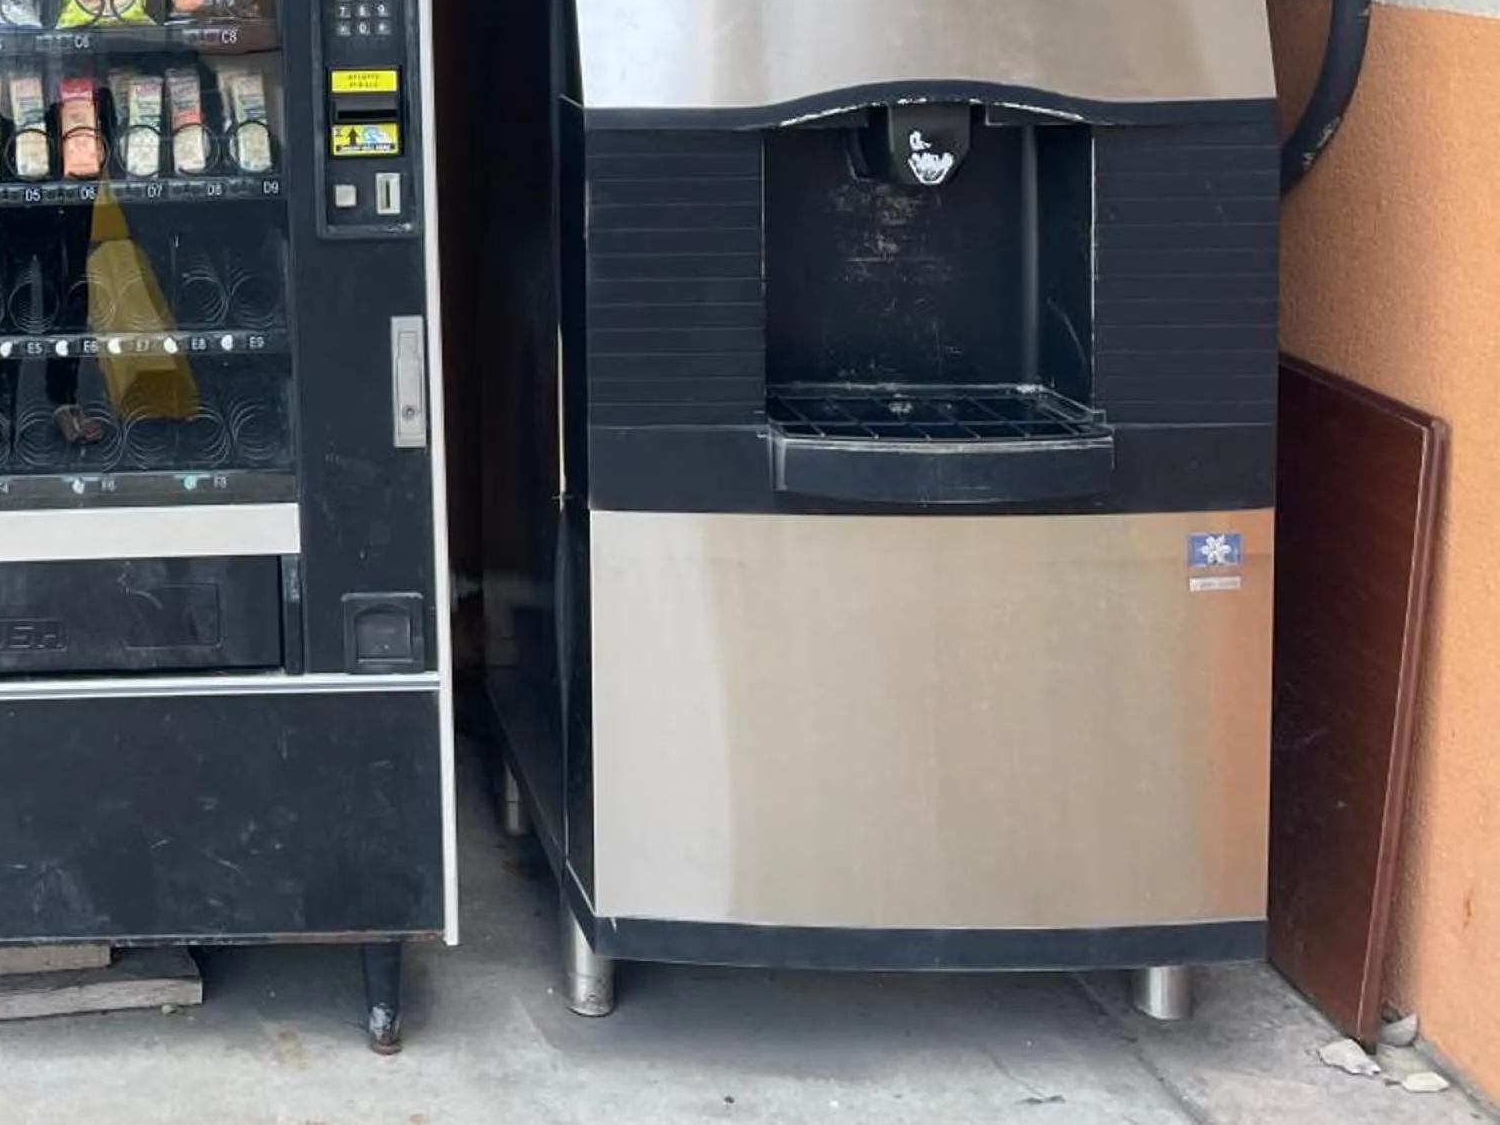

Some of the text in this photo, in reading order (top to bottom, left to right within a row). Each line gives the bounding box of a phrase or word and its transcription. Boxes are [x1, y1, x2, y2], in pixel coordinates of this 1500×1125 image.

[221, 30, 238, 43] C8
[80, 187, 96, 199] D6
[147, 185, 163, 198] D7
[207, 184, 223, 196] D8
[263, 181, 279, 194] D9
[25, 189, 41, 201] D5
[27, 341, 43, 354] E5
[83, 340, 99, 353] E6
[192, 338, 206, 350] E8
[249, 336, 265, 348] E9
